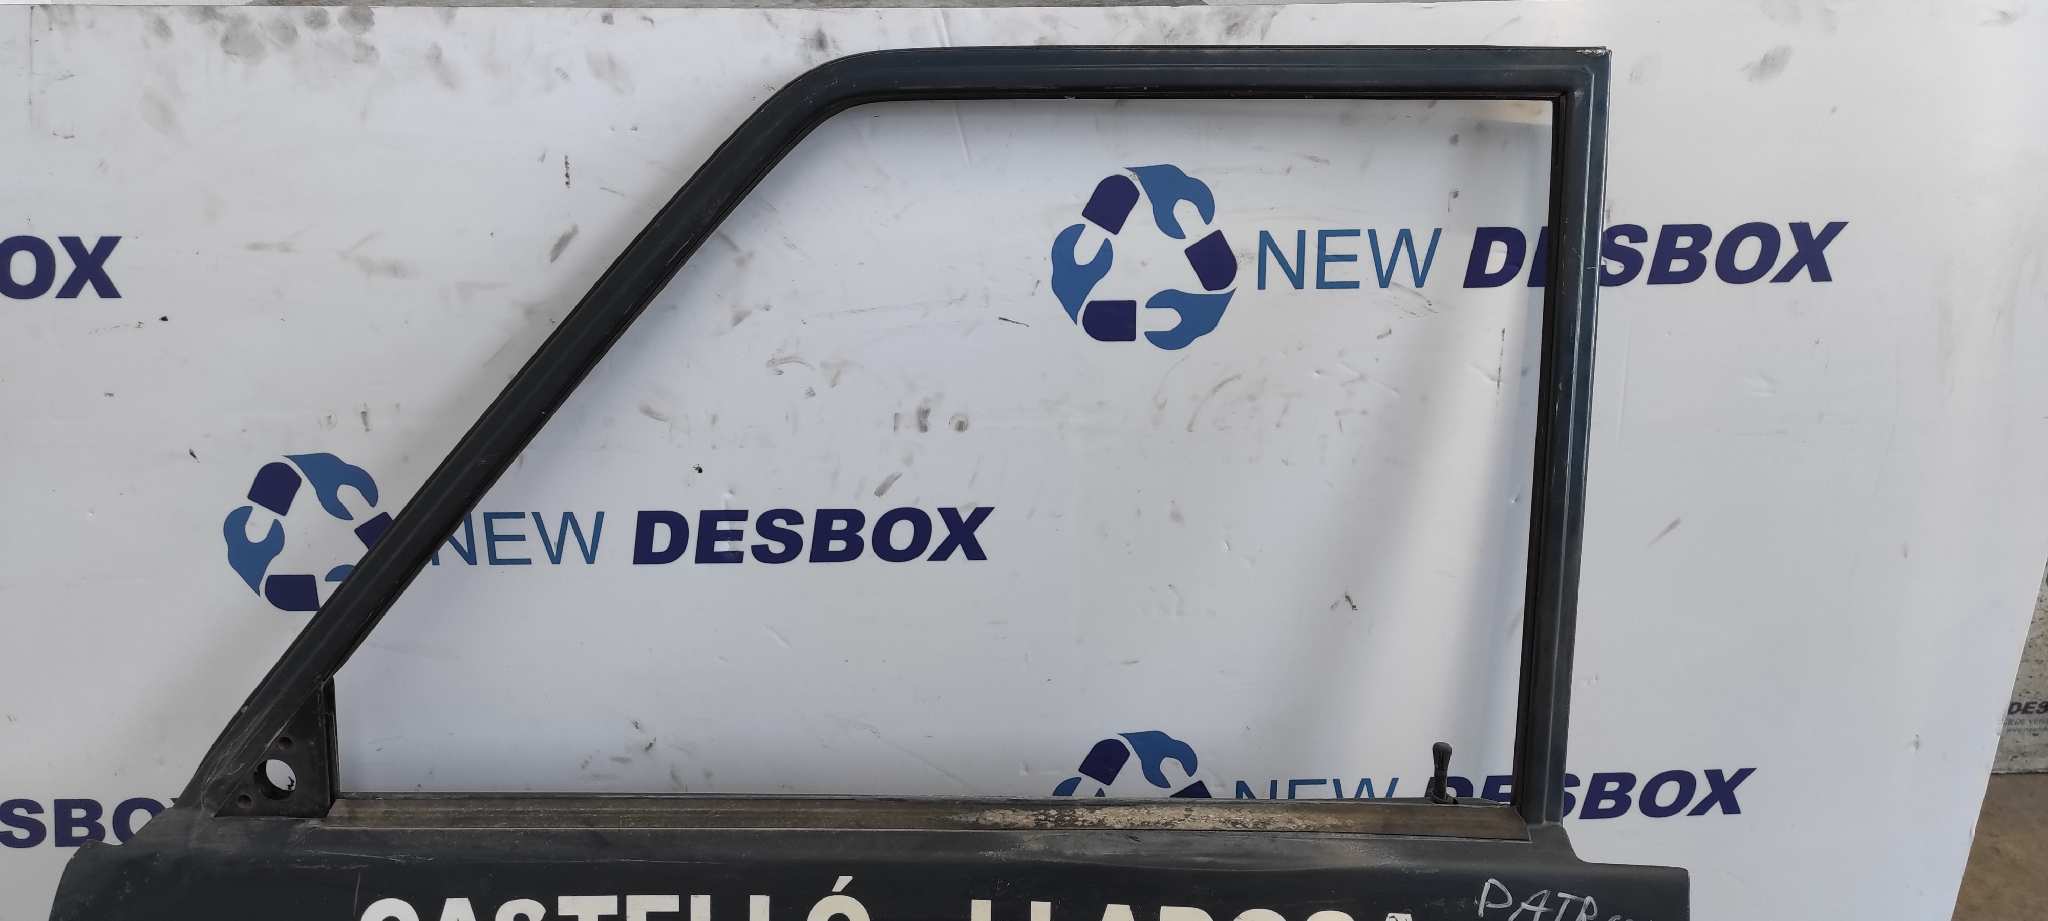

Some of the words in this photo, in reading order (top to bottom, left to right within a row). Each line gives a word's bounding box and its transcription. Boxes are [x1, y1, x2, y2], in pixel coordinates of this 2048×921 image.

[0, 235, 122, 299] OX
[1257, 228, 1442, 290] NEW
[632, 507, 994, 564] DESBOX
[0, 797, 176, 848] SBO
[1478, 878, 1652, 921] PATR
